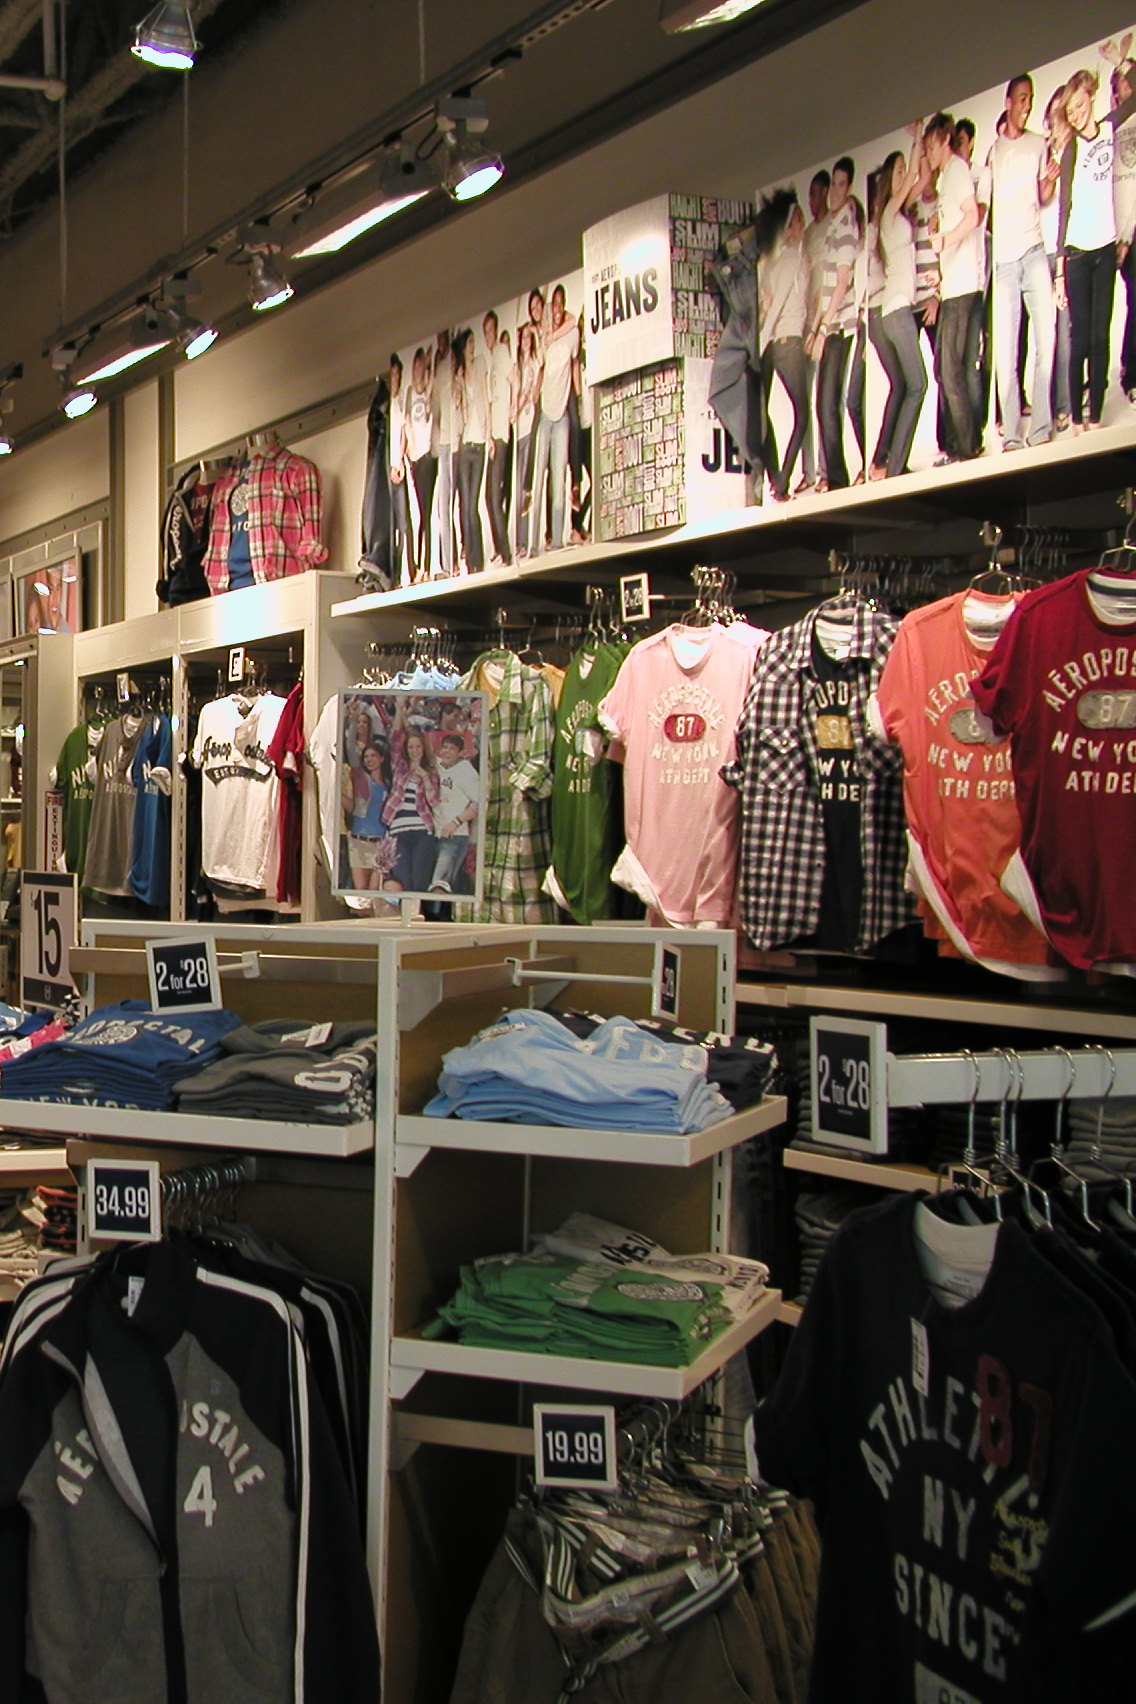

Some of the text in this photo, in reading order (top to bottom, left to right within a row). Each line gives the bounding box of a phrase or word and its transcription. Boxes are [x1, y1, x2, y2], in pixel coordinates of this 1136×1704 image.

[591, 267, 659, 335] JEANS
[676, 716, 695, 738] 87
[1099, 695, 1131, 725] 87
[651, 742, 683, 763] NEW
[928, 744, 974, 772] NEW
[1051, 731, 1104, 762] NEW
[156, 956, 209, 991] 2 for $28
[818, 1054, 831, 1103] 2
[831, 1079, 845, 1105] for
[95, 1184, 149, 1219] 34.99
[545, 1430, 604, 1465] 19.99
[183, 1465, 217, 1527] 4
[923, 1474, 977, 1562] NY
[894, 1553, 1007, 1682] SINCE
